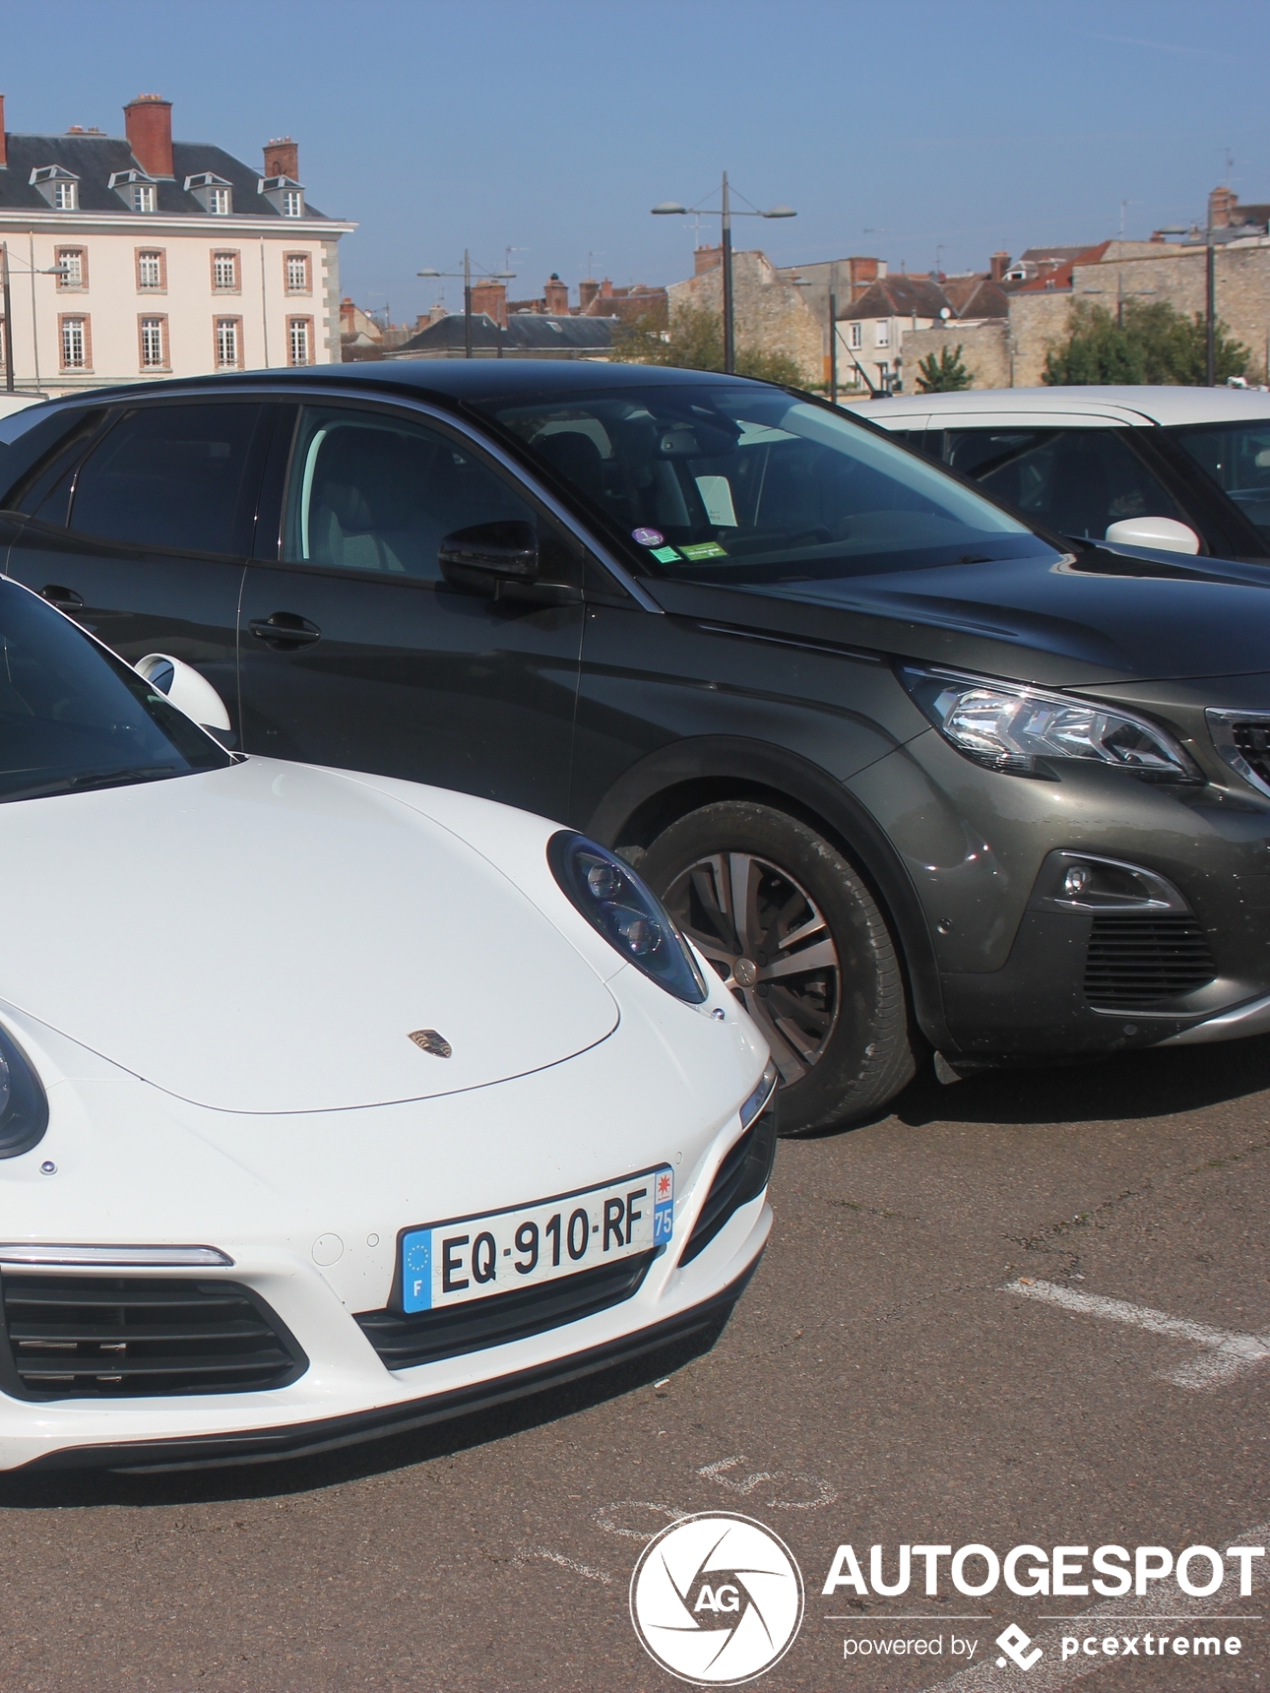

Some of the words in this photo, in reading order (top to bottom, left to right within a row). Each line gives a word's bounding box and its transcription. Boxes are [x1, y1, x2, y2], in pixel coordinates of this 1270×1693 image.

[655, 1208, 672, 1237] 75
[442, 1187, 647, 1294] EQ-910-RF
[413, 1279, 422, 1297] F
